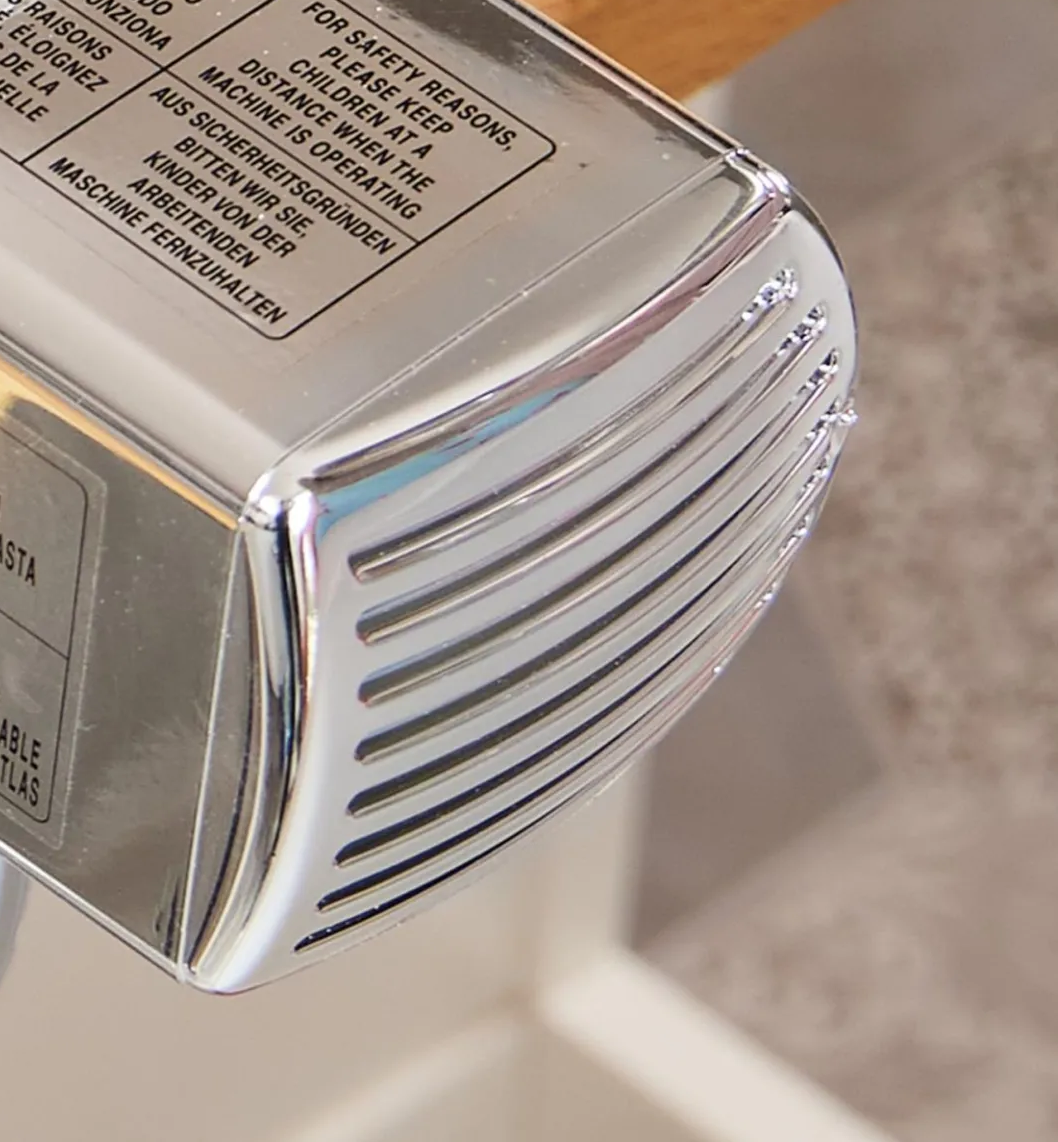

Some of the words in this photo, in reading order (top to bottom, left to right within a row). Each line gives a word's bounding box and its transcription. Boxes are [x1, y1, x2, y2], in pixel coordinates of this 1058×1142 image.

[7, 23, 110, 93] ÉLOIGNEZ
[23, 0, 114, 61] RAISONS
[301, 1, 350, 35] FOR
[344, 29, 427, 83] SAFETY
[418, 78, 518, 152] REASONS,
[27, 71, 61, 97] LA
[237, 58, 339, 128] DISTANCE
[332, 120, 396, 167] WHEN
[389, 159, 436, 194] THE
[288, 58, 391, 129] CHILDREN
[382, 124, 419, 146] AT
[410, 143, 434, 160] A
[318, 45, 402, 102] PLEASE
[394, 96, 455, 134] KEEP
[148, 86, 196, 117] AUS
[188, 111, 398, 255] SICHERHEITSGRÜNDEN
[173, 136, 247, 188] BITTEN
[238, 179, 282, 212] WIR
[274, 206, 315, 239] SIE,
[197, 65, 292, 130] MACHINE
[284, 124, 314, 145] IS
[309, 141, 423, 220] OPERATING
[47, 156, 150, 229] MASCHINE
[140, 220, 289, 325] FERNZUHALTEN
[126, 177, 261, 269] ARBEITENDEN
[142, 150, 219, 205] KINDER
[211, 196, 259, 231] VON
[249, 224, 297, 259] DER
